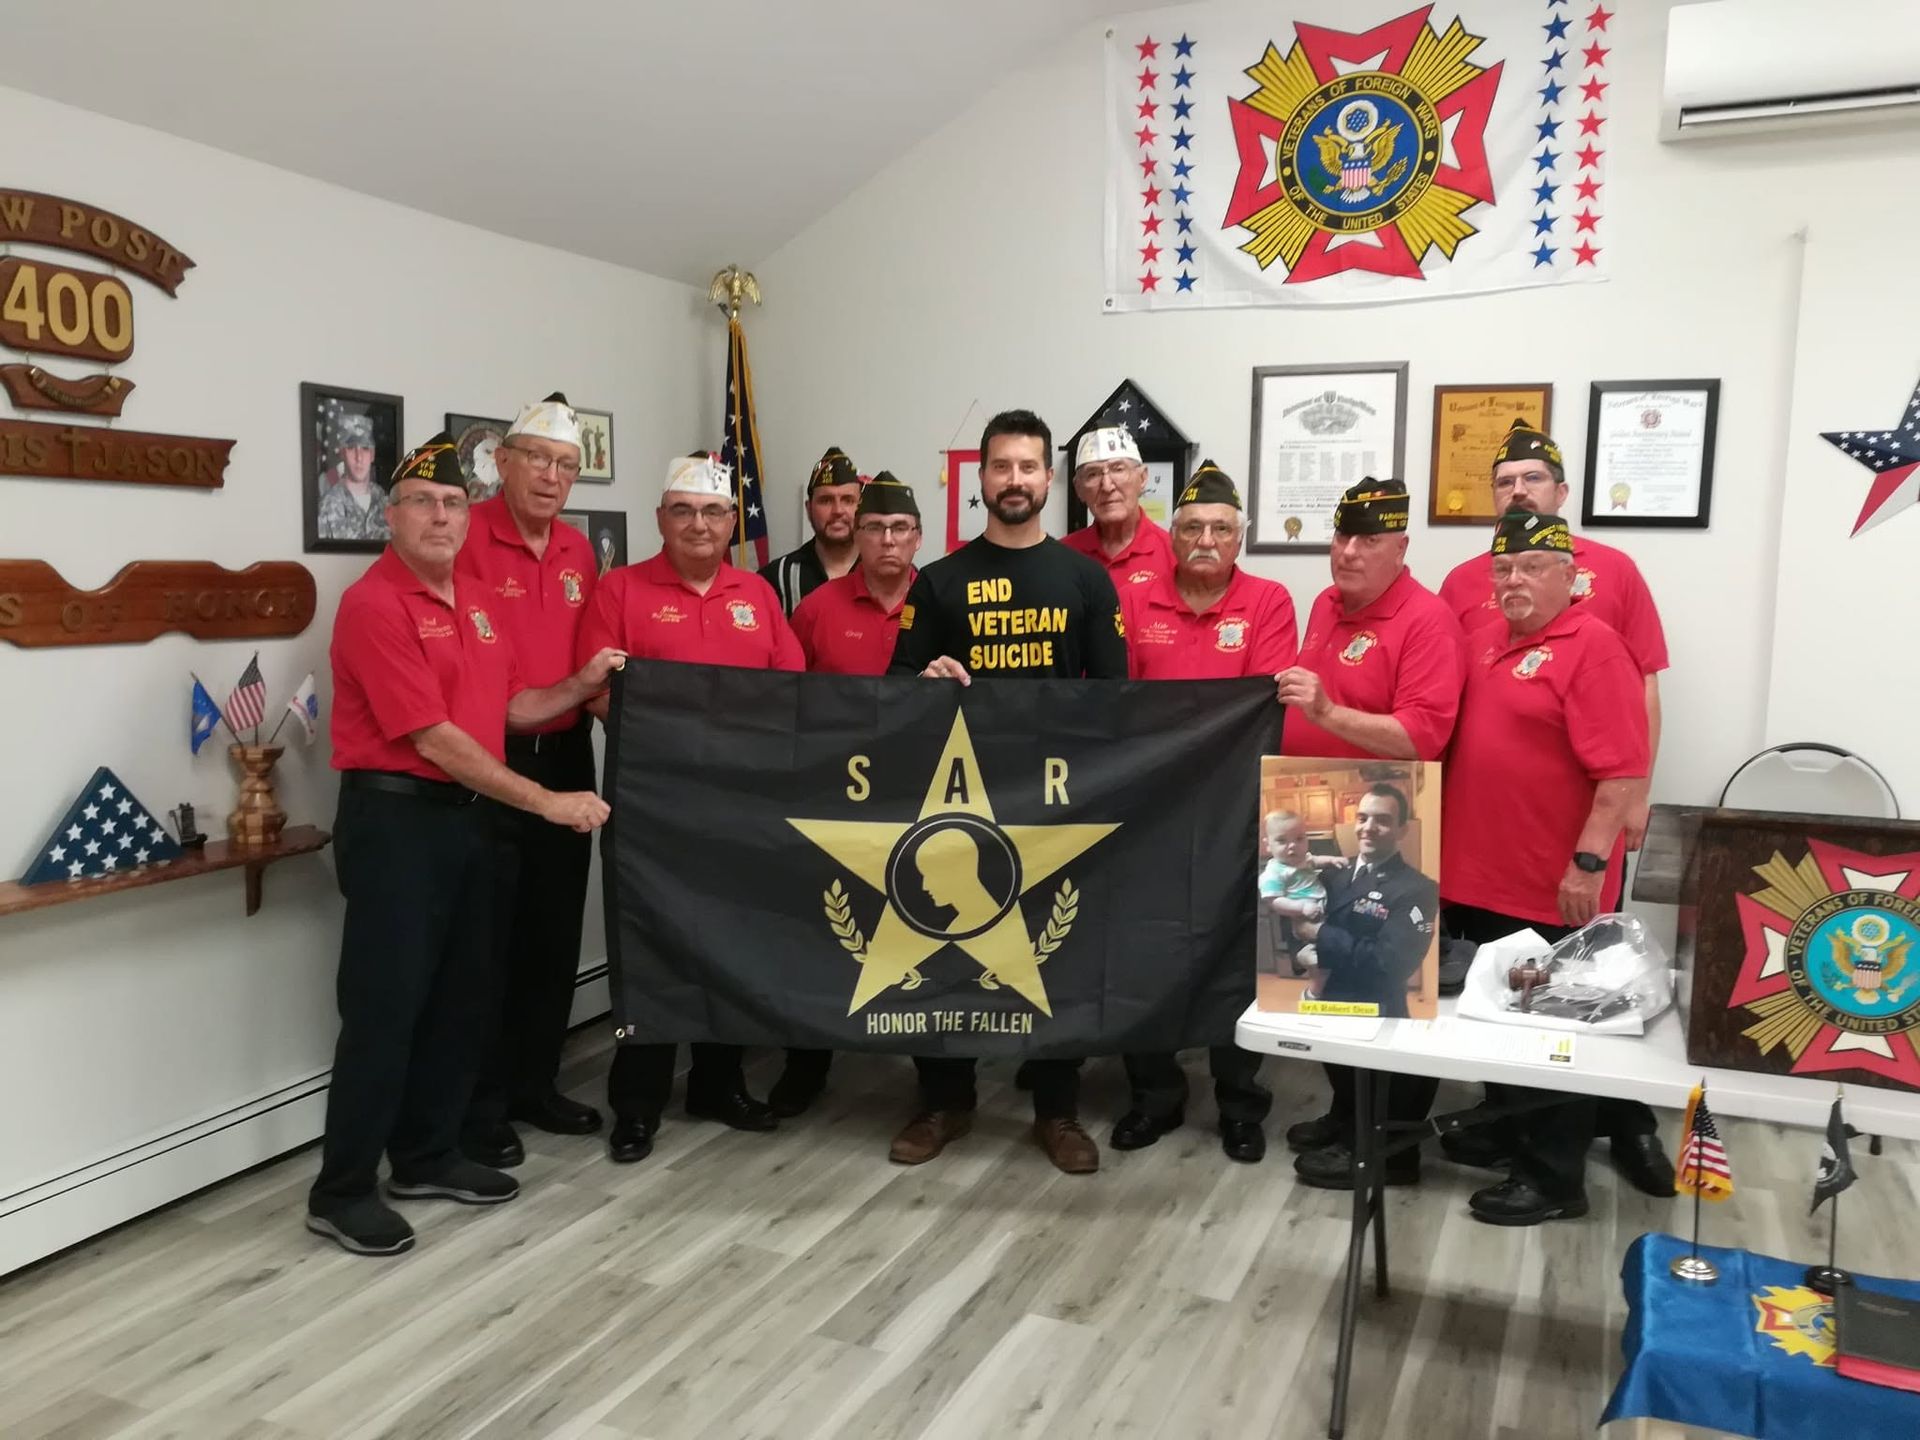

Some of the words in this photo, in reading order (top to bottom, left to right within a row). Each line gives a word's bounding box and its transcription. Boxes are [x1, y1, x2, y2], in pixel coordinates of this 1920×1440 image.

[1282, 95, 1326, 160] VETERANS
[1330, 82, 1348, 97] OF
[1355, 76, 1412, 99] FOREIGN
[1415, 101, 1438, 139] WARS
[1289, 186, 1304, 202] OF
[1305, 204, 1329, 226] THE
[1343, 212, 1384, 230] UNITED
[1397, 171, 1429, 211] STATES
[59, 204, 182, 277] POST
[4, 265, 133, 353] 400
[92, 441, 217, 481] JASON
[419, 462, 437, 471] VFW
[61, 600, 123, 633] OF
[162, 587, 298, 623] HONOR
[967, 577, 1013, 605] END
[968, 607, 1068, 637] VETERAN
[969, 641, 1054, 670] SUICIDE
[846, 754, 871, 802] S
[944, 757, 970, 805] A
[1044, 757, 1071, 806] R
[1788, 896, 1844, 956] VETERANS
[1848, 892, 1870, 907] OF
[867, 1012, 928, 1035] HONOR
[932, 1010, 965, 1033] THE
[970, 1012, 1033, 1035] FALLEN
[1804, 994, 1832, 1019] THE
[1835, 1014, 1899, 1033] UNITED
